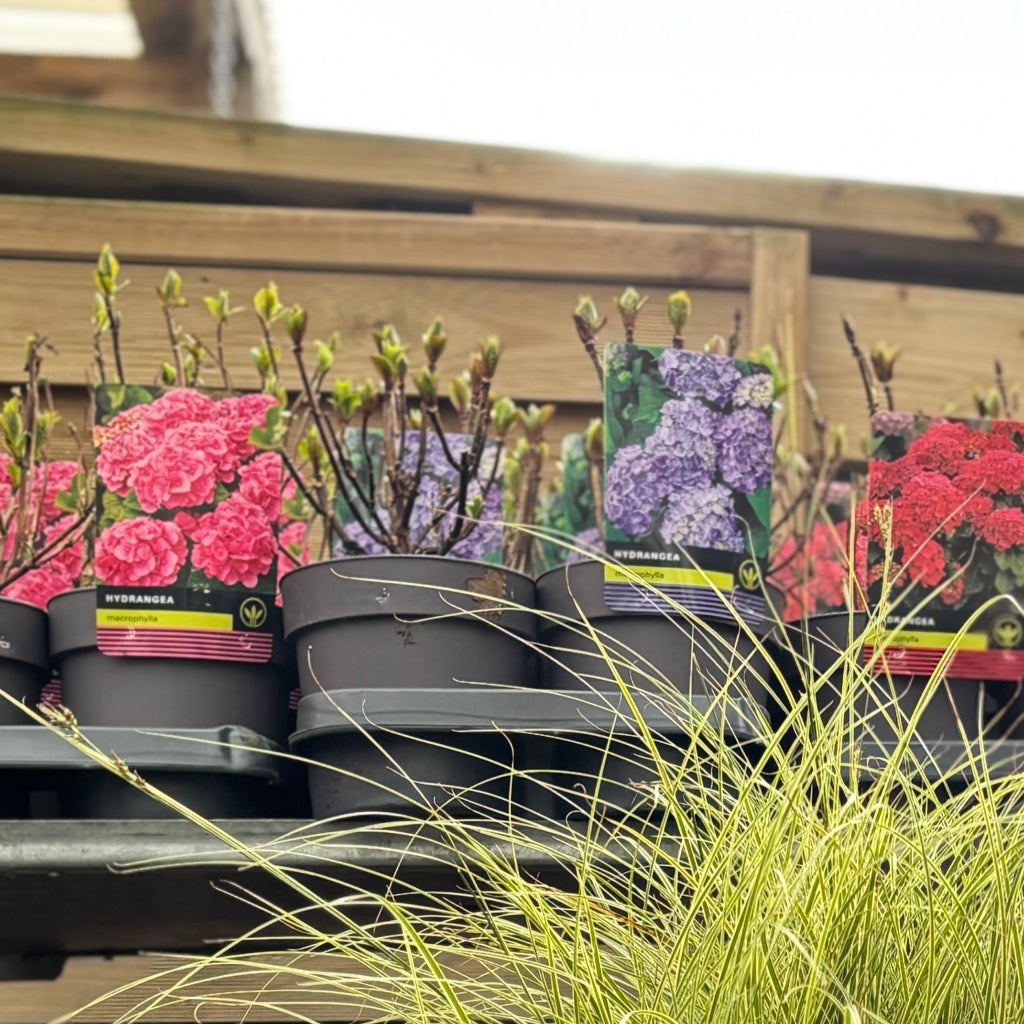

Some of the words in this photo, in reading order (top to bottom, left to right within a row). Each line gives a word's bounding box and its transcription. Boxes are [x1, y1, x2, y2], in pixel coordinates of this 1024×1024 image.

[613, 550, 680, 562] HYDRANGEA
[105, 594, 175, 605] HYDRANGEA
[106, 612, 159, 624] macrophylla
